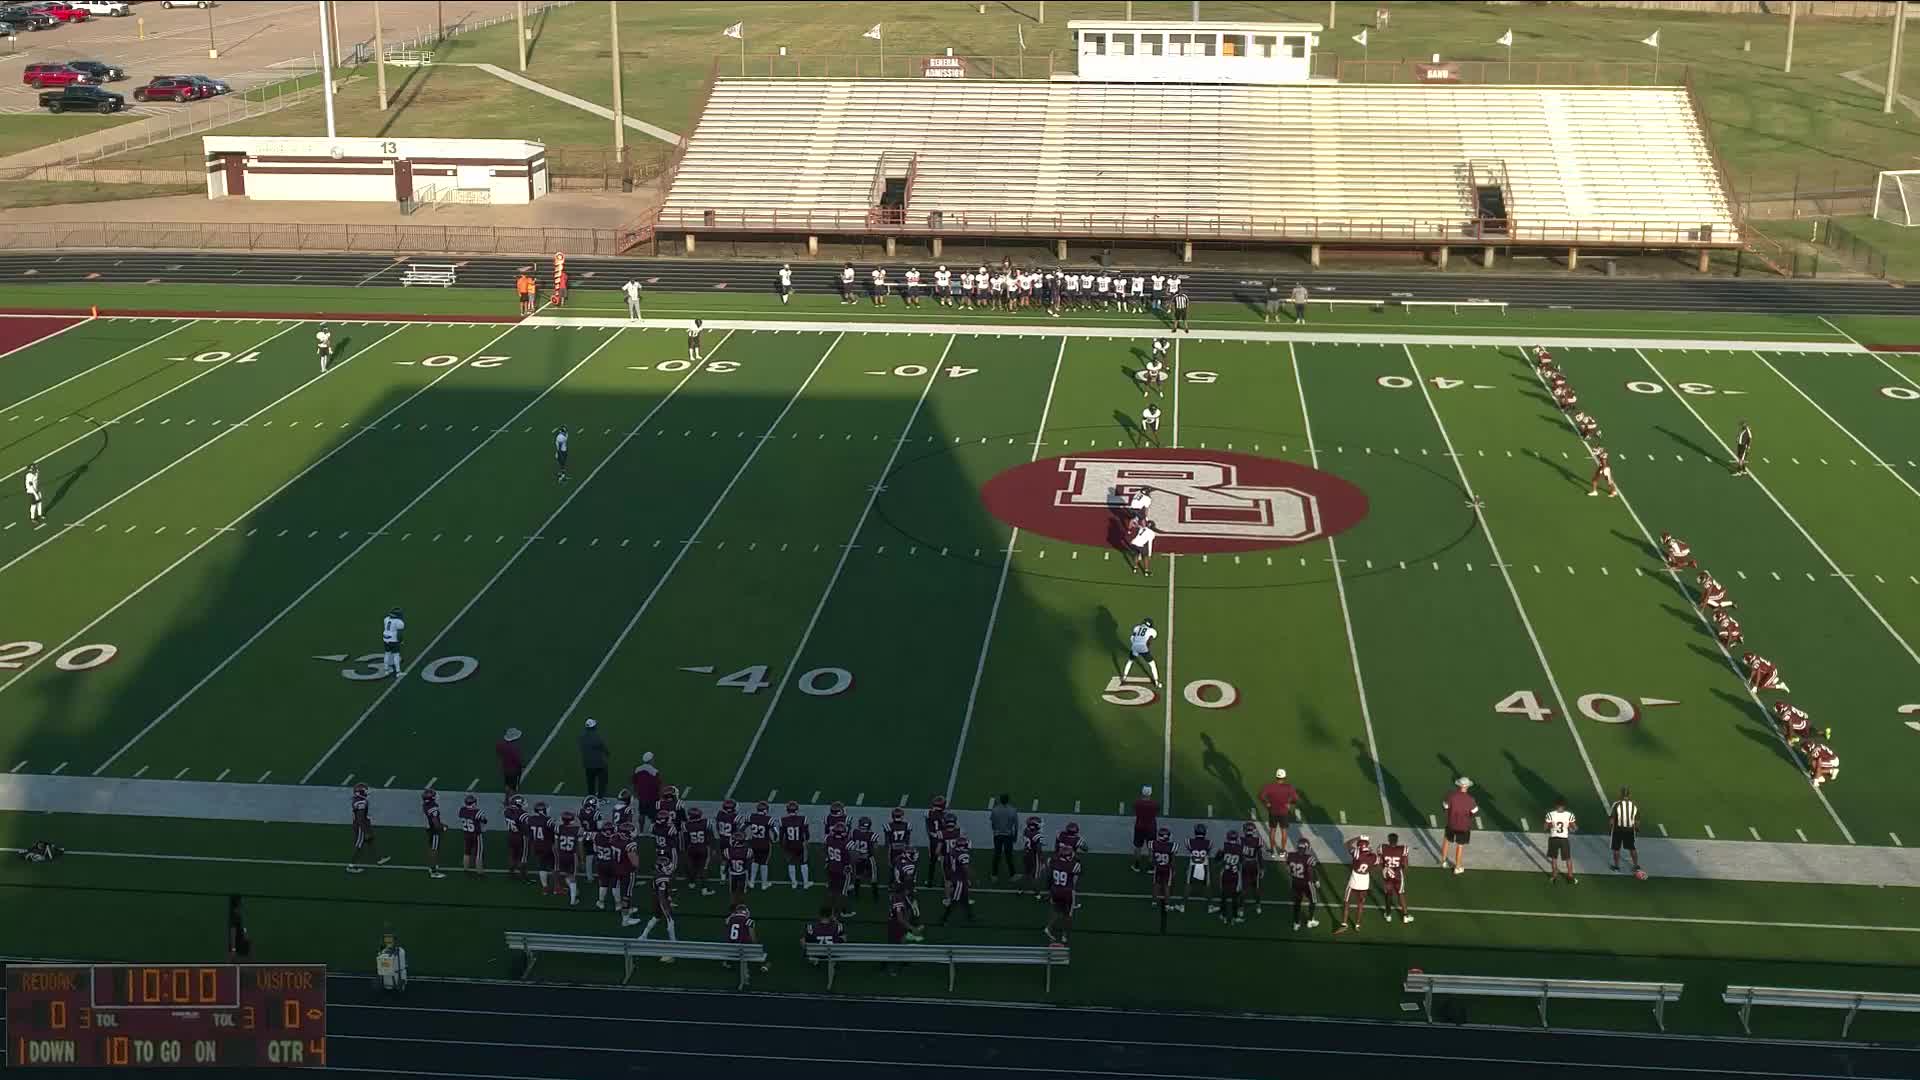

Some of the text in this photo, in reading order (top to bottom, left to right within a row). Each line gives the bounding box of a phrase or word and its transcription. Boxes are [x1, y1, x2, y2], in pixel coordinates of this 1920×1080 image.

[930, 58, 960, 67] GENERAL
[925, 69, 964, 77] ADMISSION
[380, 141, 397, 154] 13
[1136, 627, 1148, 637] 18
[529, 826, 544, 840] 74
[751, 824, 766, 838] 23
[786, 826, 800, 841] 91
[1556, 821, 1564, 834] 3
[560, 836, 576, 851] 25
[1384, 855, 1401, 868] 35
[1289, 862, 1305, 879] 32
[1053, 870, 1068, 887] 99
[730, 923, 740, 940] 6
